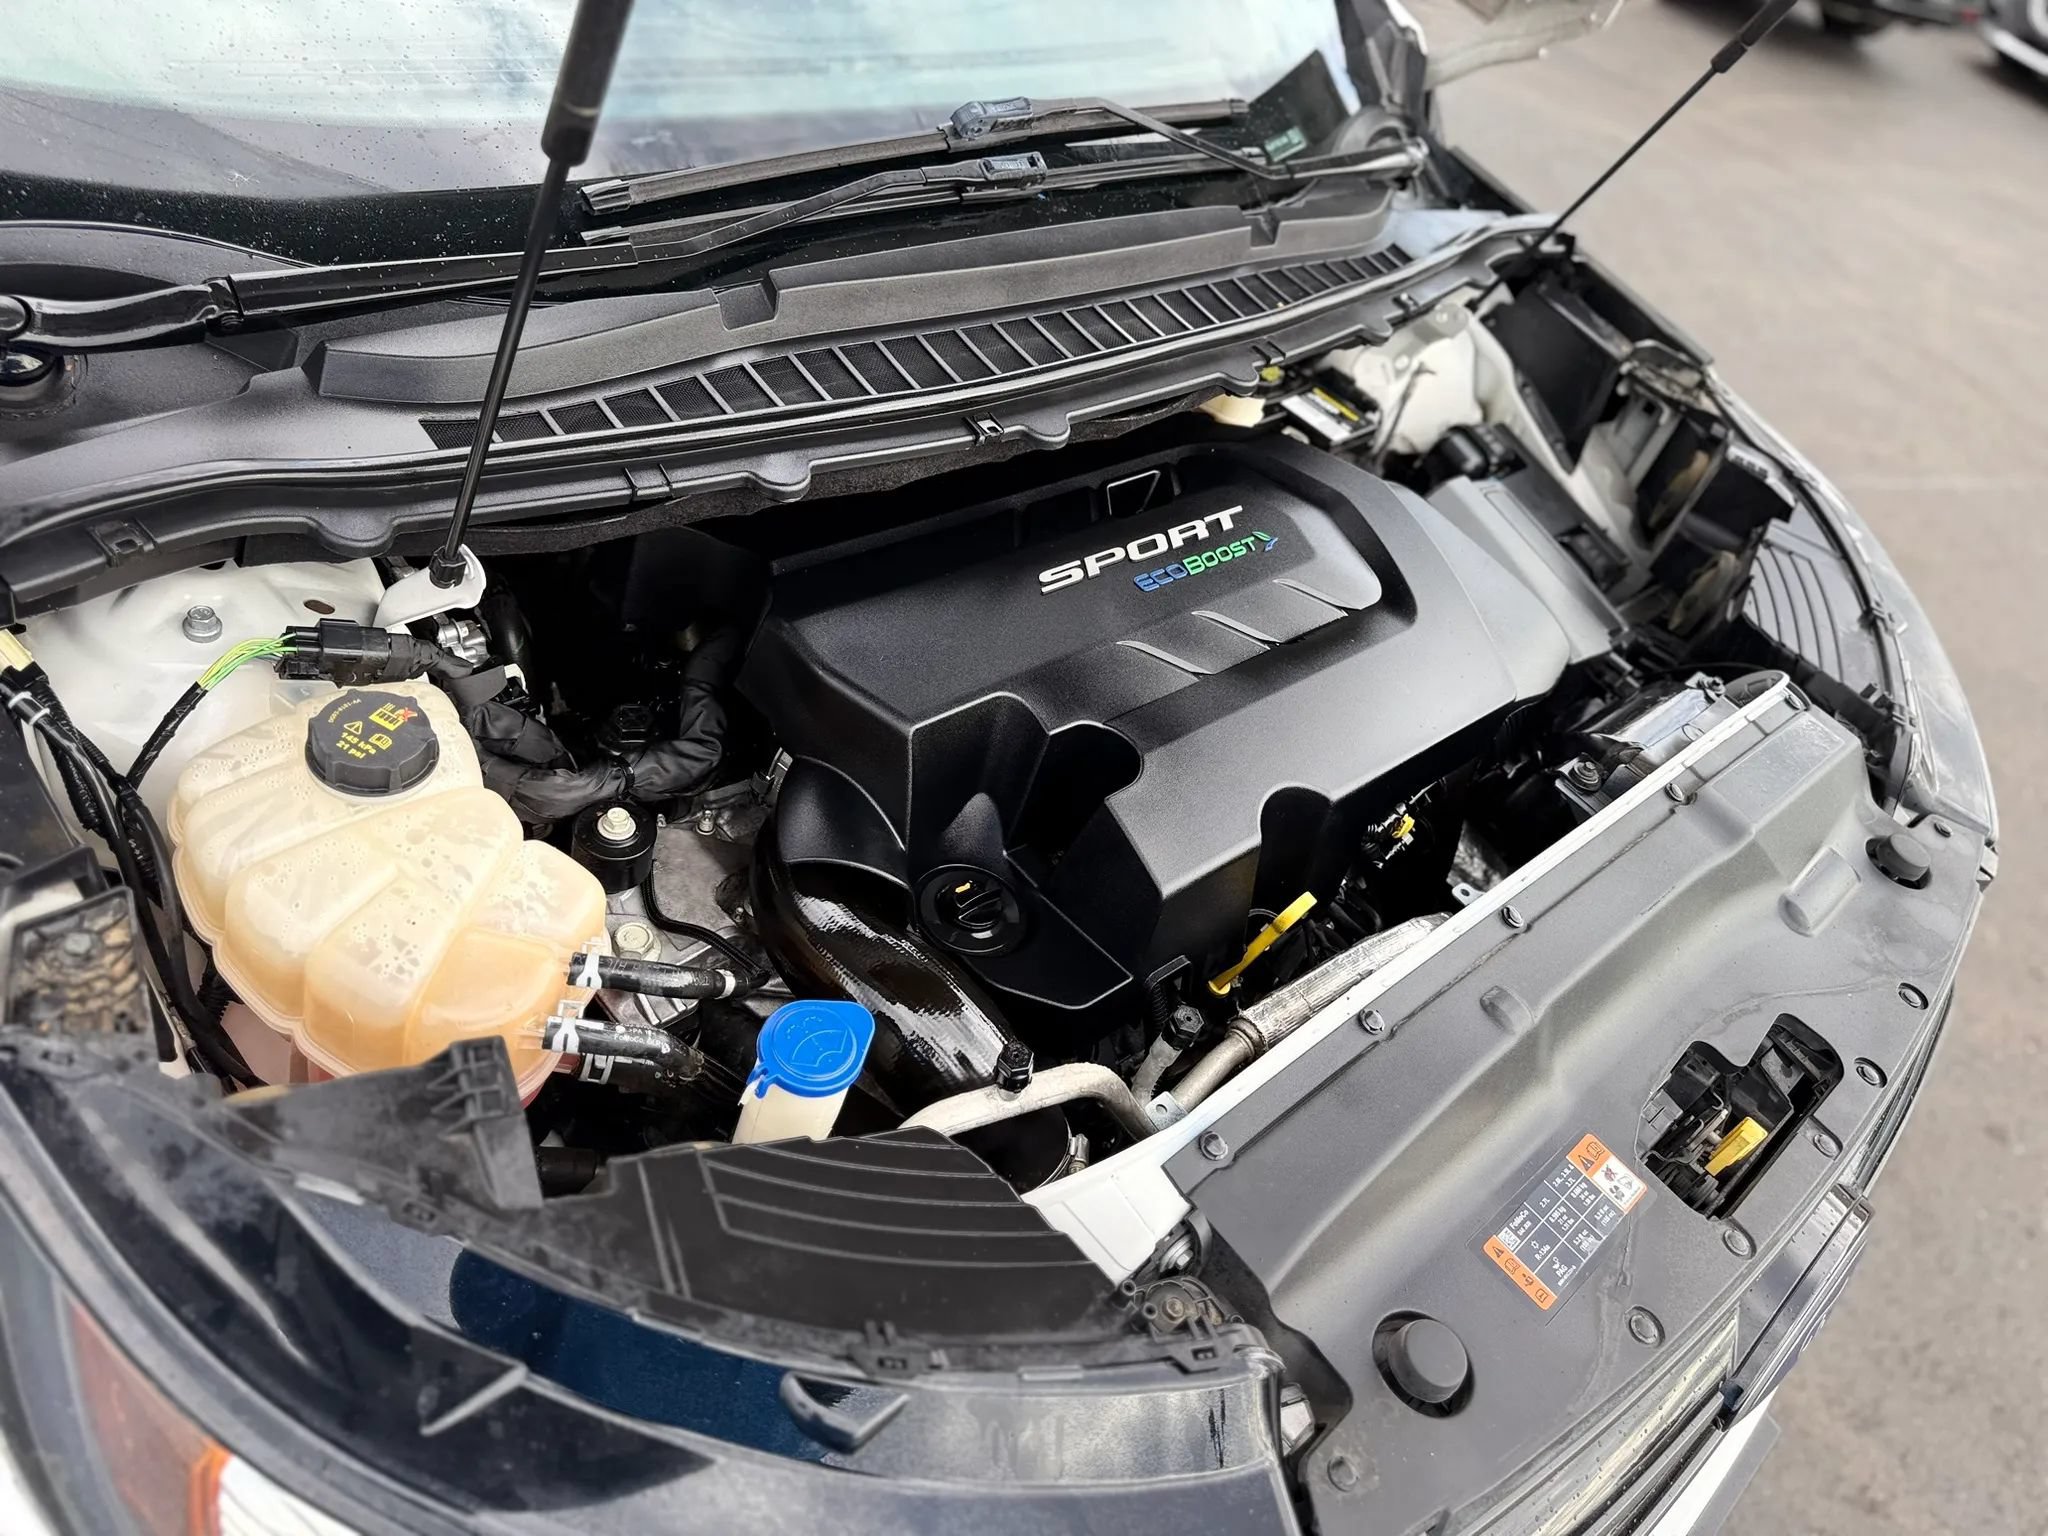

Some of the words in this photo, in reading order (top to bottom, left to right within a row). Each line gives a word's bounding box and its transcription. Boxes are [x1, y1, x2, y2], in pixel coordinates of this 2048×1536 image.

[1038, 505, 1243, 594] SPORT
[336, 740, 350, 751] 21
[348, 748, 366, 759] psi
[341, 732, 359, 745] 145
[357, 740, 377, 756] kPa
[1556, 1264, 1568, 1277] PAG
